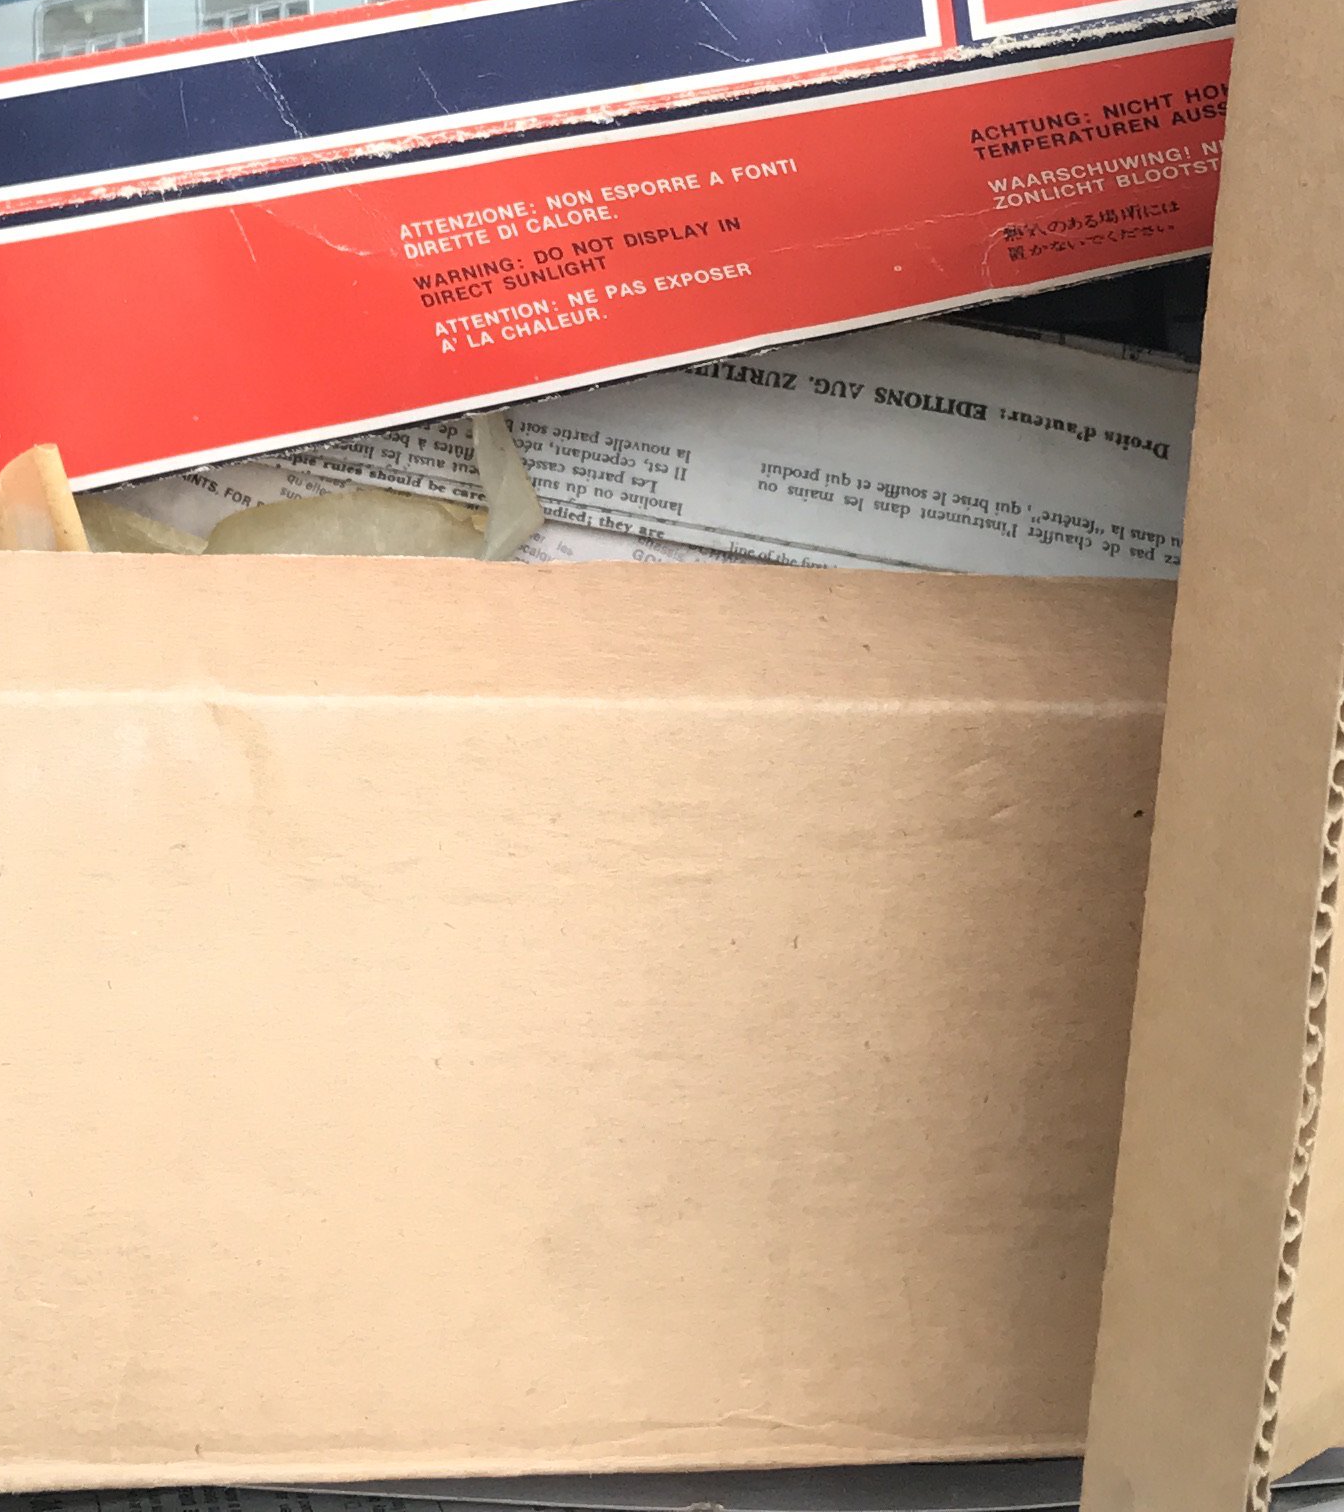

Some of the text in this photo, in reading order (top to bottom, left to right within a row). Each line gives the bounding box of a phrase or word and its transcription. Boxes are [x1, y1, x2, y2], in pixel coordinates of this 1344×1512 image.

[968, 92, 1174, 143] ACHTUNG: NICHT
[975, 116, 1159, 161] TEMPERATUREN
[988, 145, 1191, 194] WAARSCHUWING!
[993, 178, 1105, 210] ZONLICHT
[398, 157, 797, 241] ATTENZIONE: NON ESPORRE A FONTI
[402, 203, 619, 260] DIRETTE DI CALORE.
[412, 216, 740, 291] WARNING: DO NOT DISPLAY IN
[419, 255, 608, 308] DIRECT SUNLIGHT
[433, 259, 751, 337] ATTENTION: NE PAS EXPOSER
[466, 329, 495, 348] LA
[499, 306, 608, 341] CHALEUR.
[807, 375, 1171, 459] Droits d'auteur: EDITIONS AUG.
[756, 479, 1155, 560] pas de chauffer l'instrument dans les mains ou
